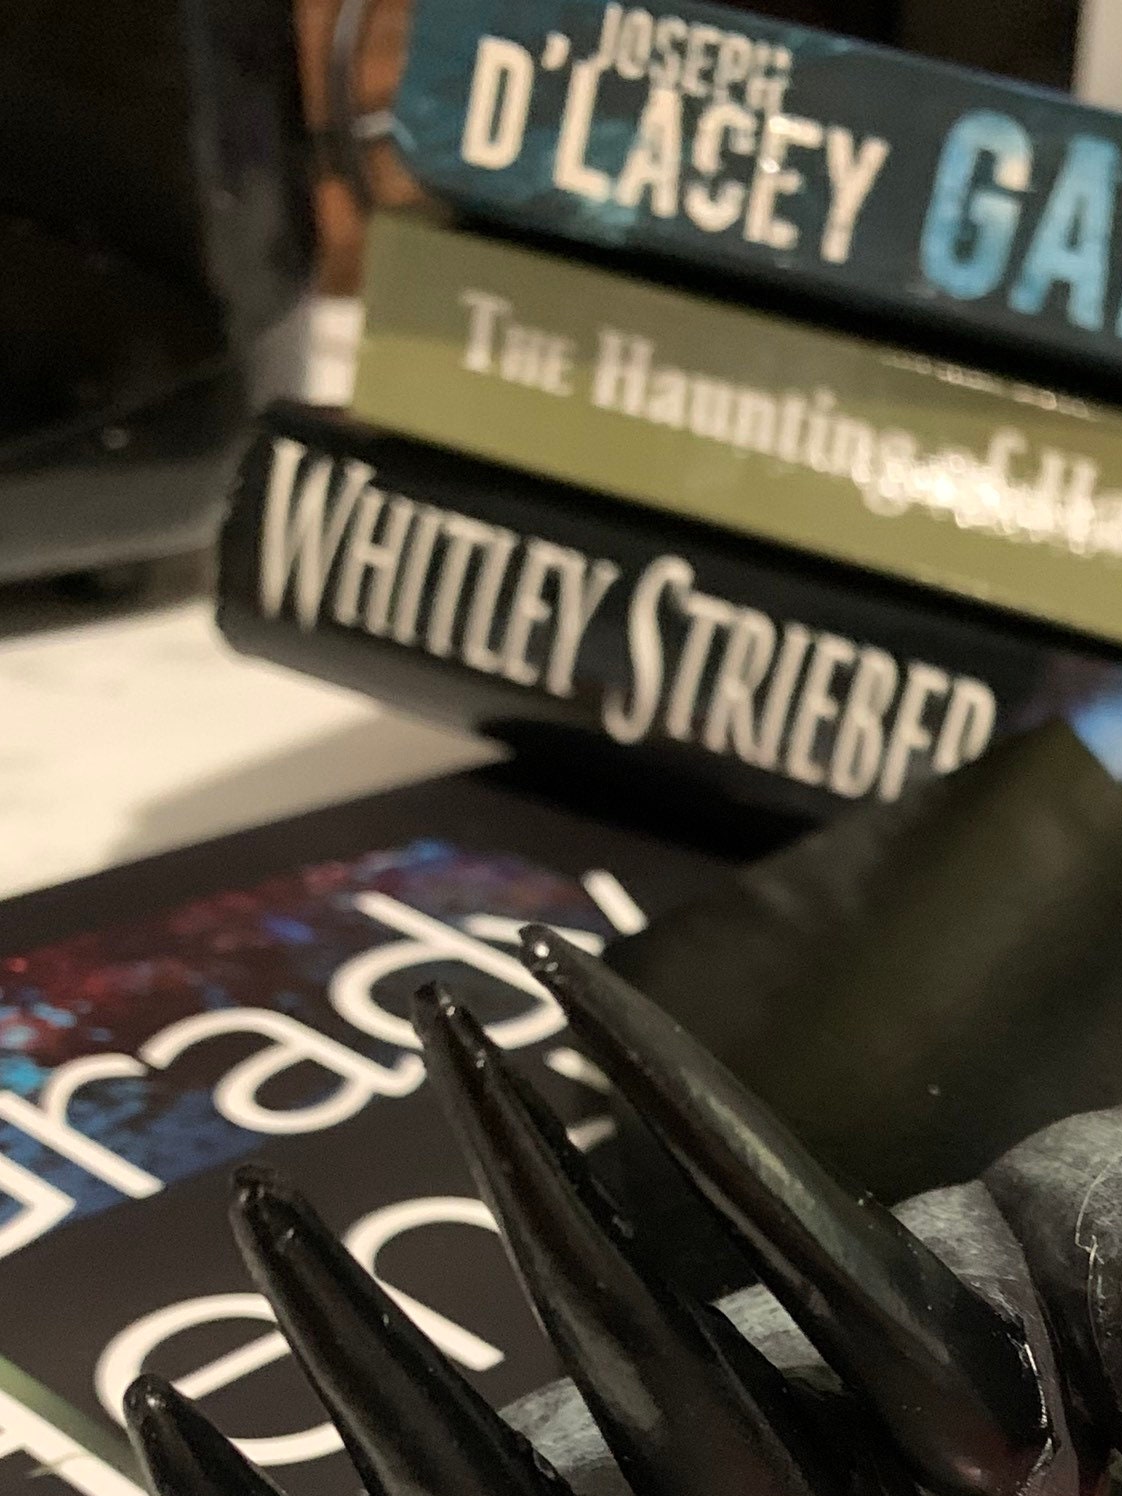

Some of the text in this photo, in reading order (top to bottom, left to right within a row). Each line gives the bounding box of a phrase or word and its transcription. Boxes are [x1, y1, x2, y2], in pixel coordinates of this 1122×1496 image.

[461, 34, 889, 264] D'LACEY
[600, 5, 791, 108] JOSEPH
[592, 328, 917, 517] Haunting
[259, 437, 622, 699] WHITLEY
